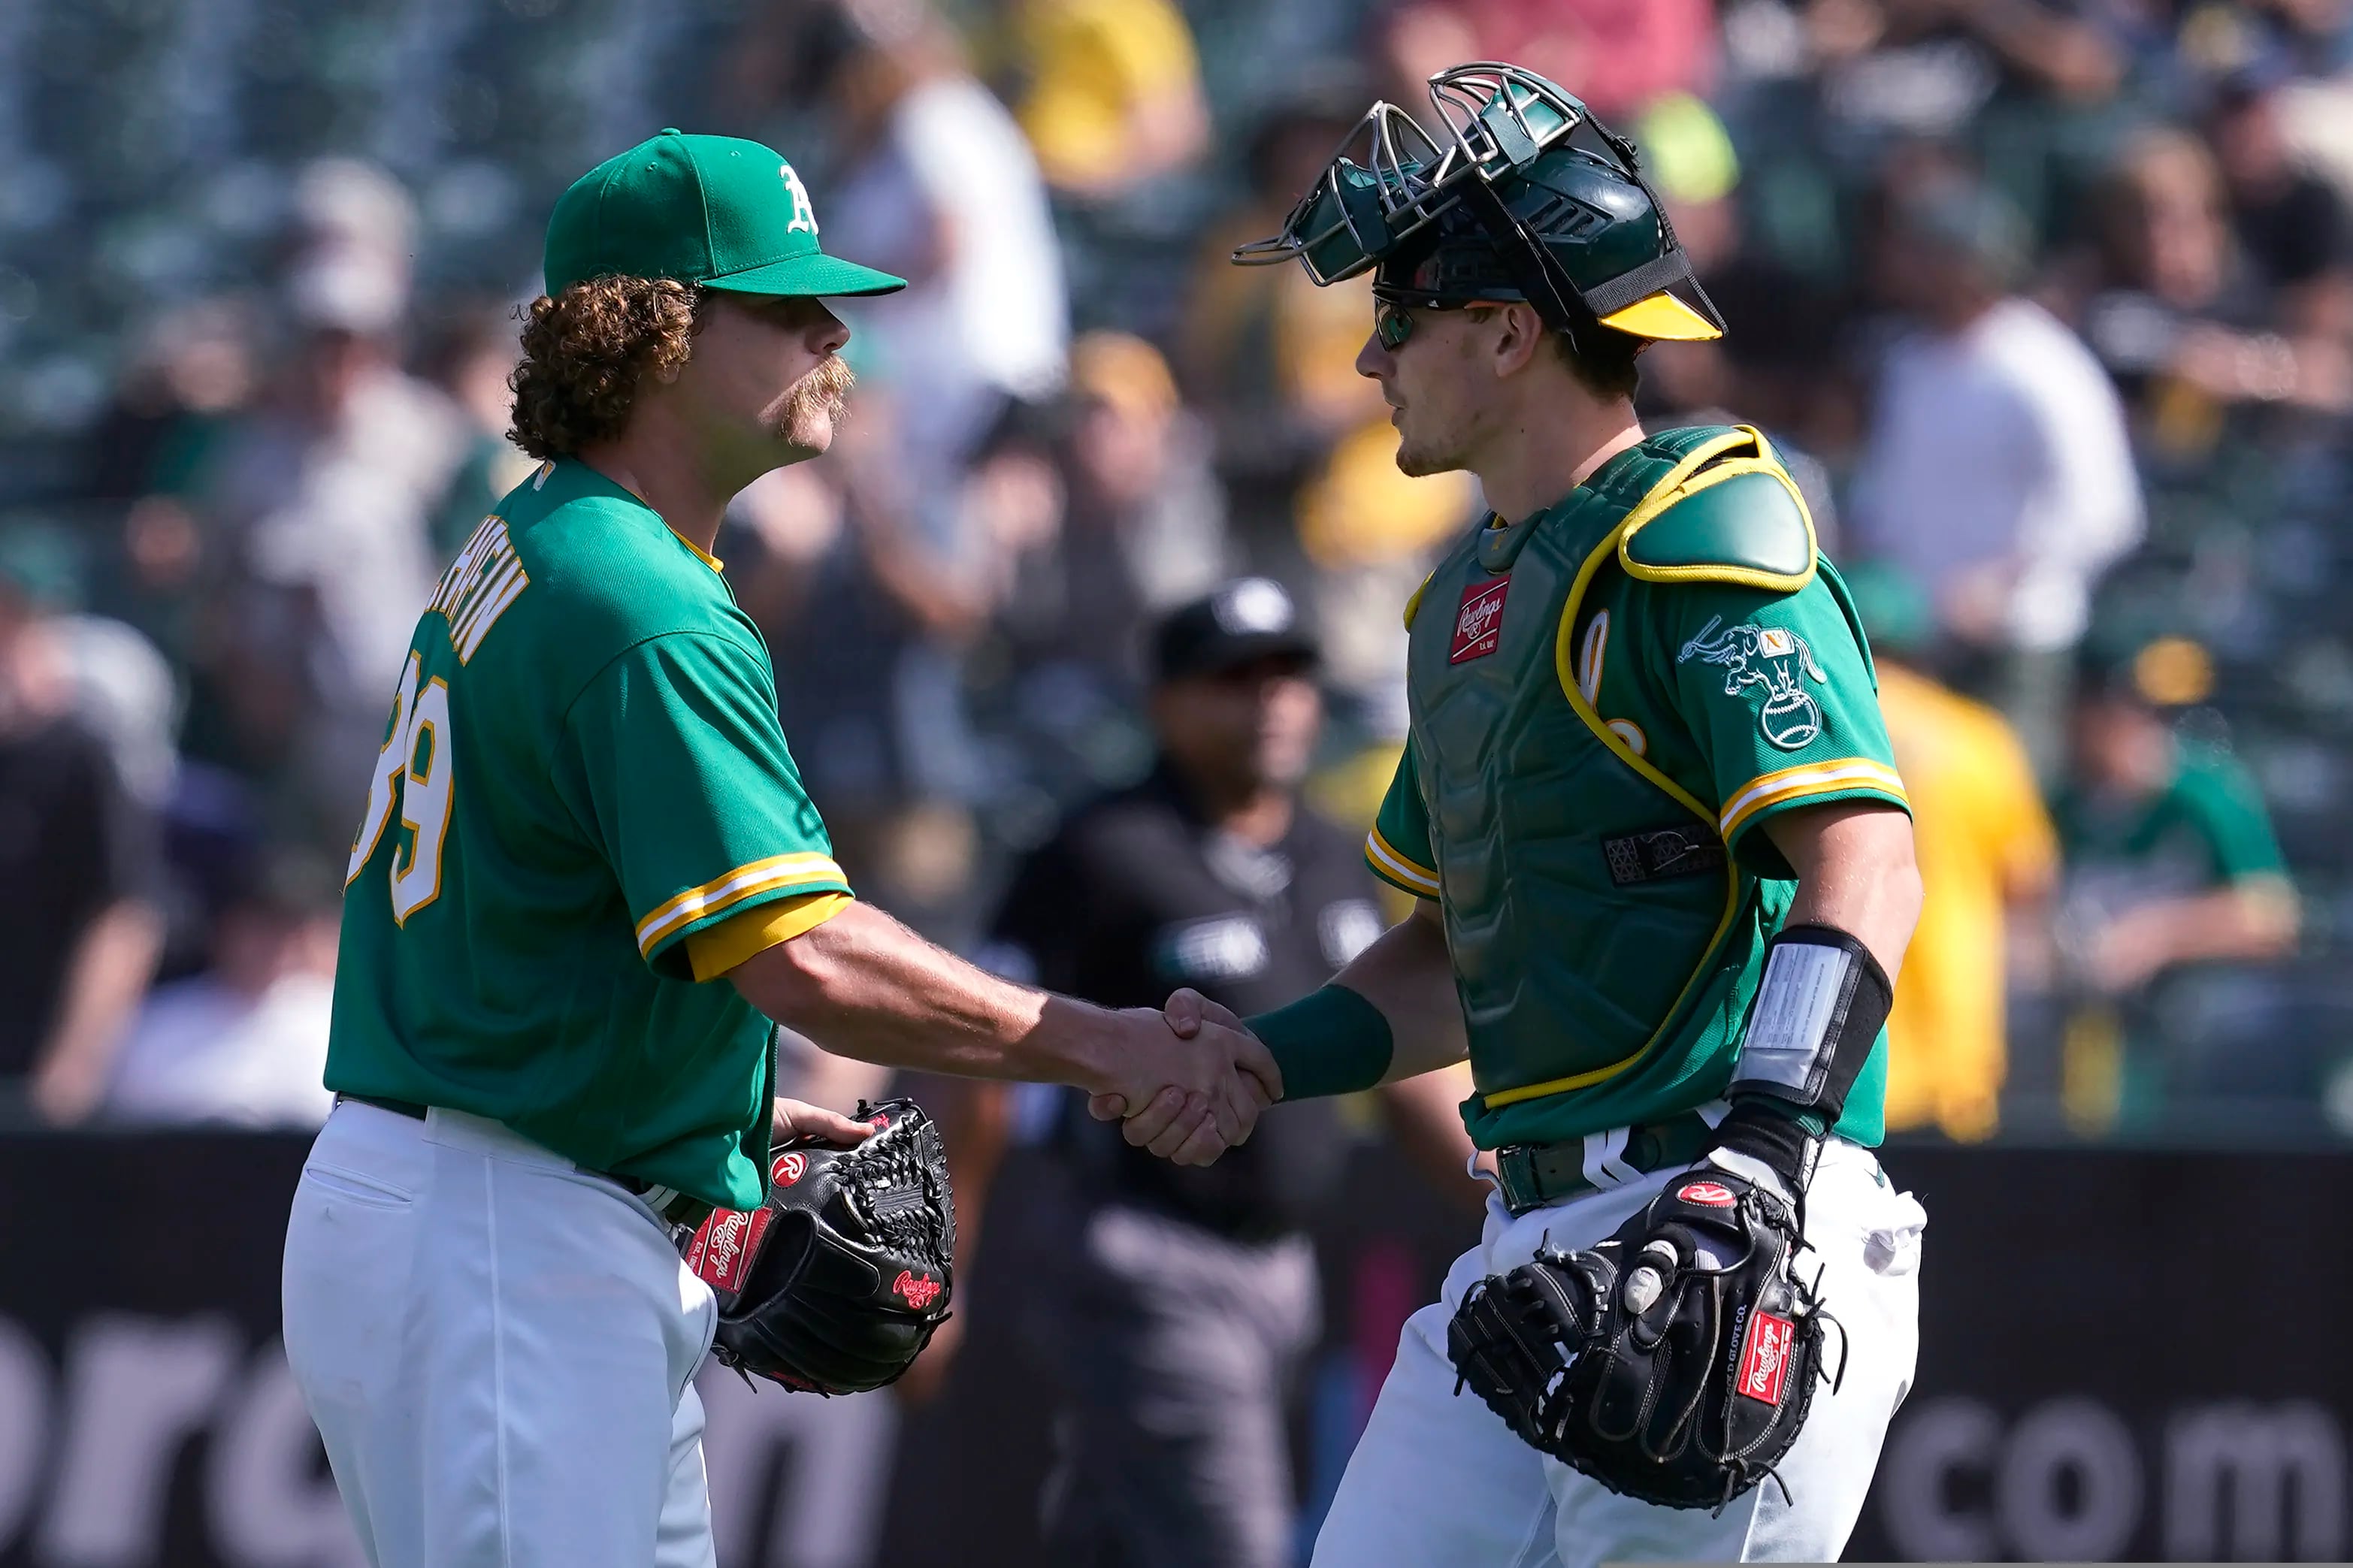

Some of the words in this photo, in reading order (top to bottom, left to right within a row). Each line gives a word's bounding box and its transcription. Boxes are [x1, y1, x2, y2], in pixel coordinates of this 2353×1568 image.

[779, 164, 819, 235] A
[423, 515, 531, 667] HAFIN
[1456, 597, 1502, 637] Rawlings
[709, 1210, 749, 1279] Rawlings
[892, 1270, 941, 1307] Rawlings
[1735, 1304, 1748, 1324] CO.
[1728, 1324, 1743, 1362] GLOVE
[1751, 1322, 1780, 1393] Rawlings
